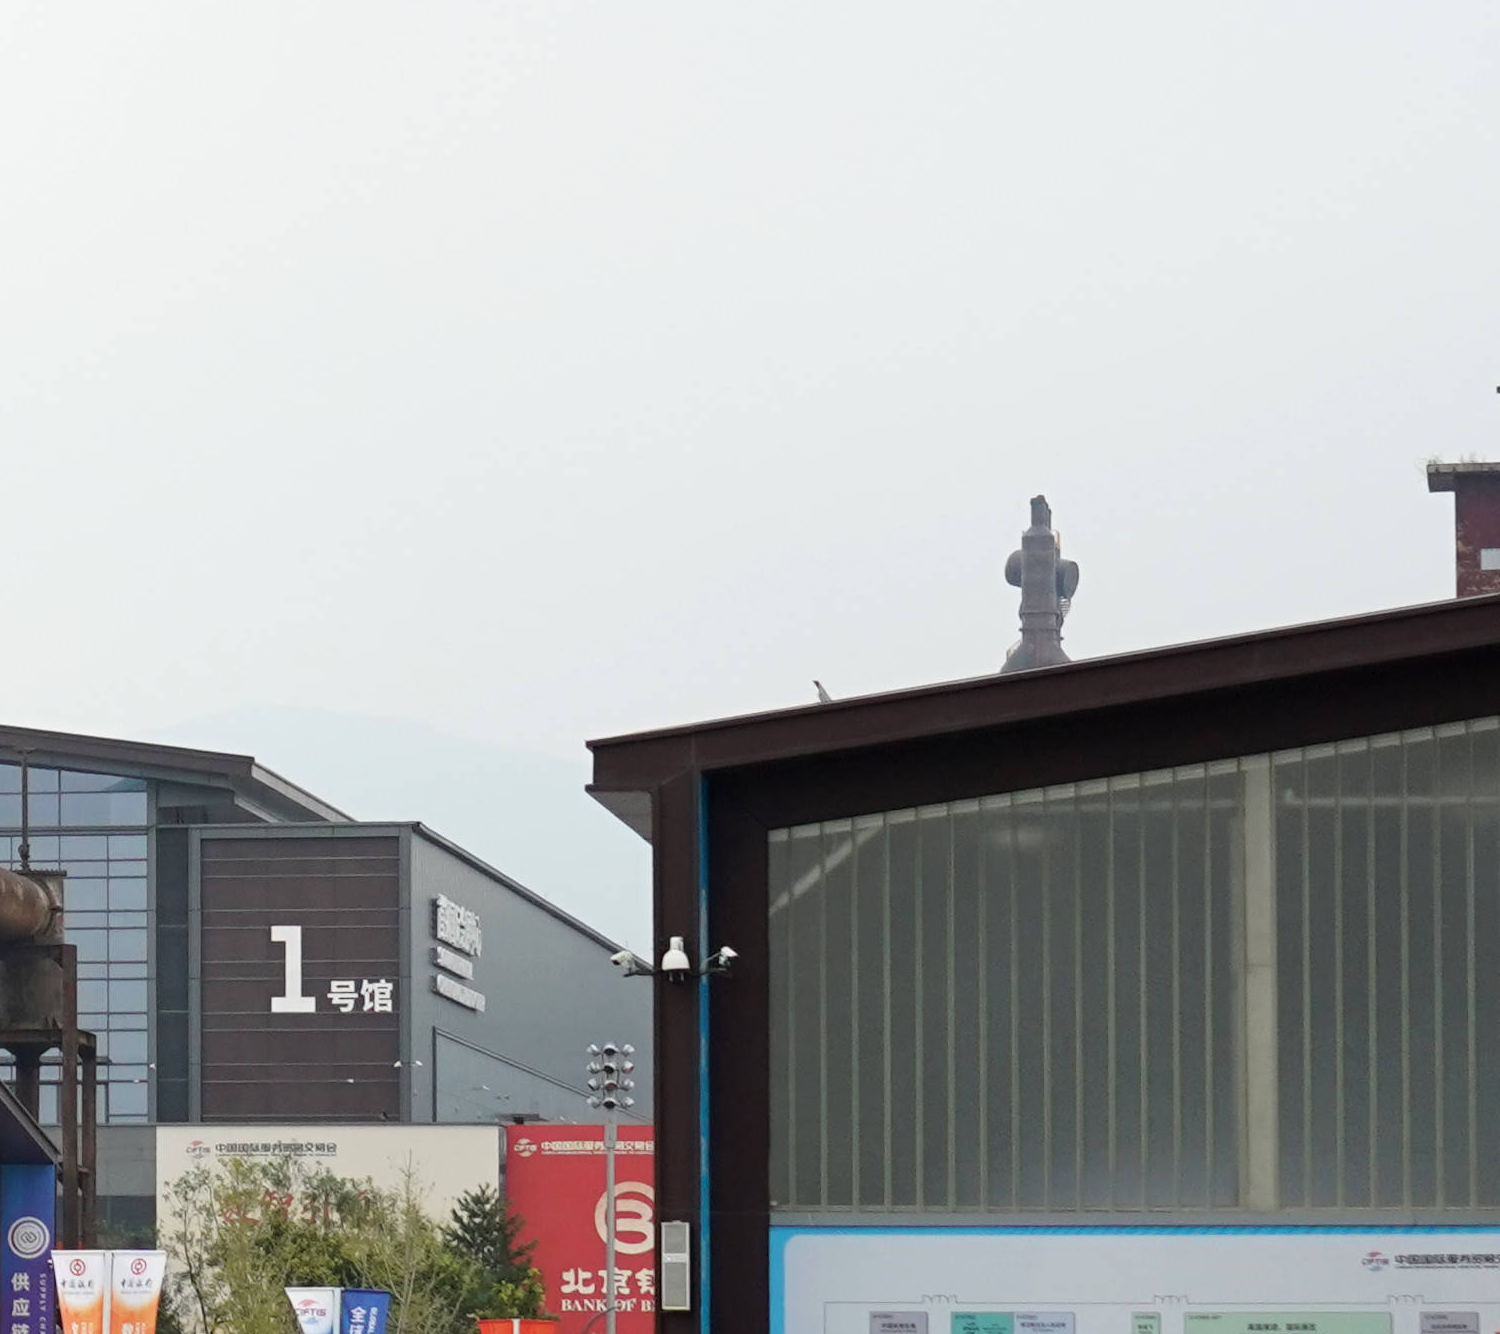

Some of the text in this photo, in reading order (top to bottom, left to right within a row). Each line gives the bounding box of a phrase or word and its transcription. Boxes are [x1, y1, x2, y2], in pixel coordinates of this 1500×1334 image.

[271, 925, 393, 1013] 1号馆
[561, 1299, 607, 1312] BANK
[614, 1298, 637, 1312] OF
